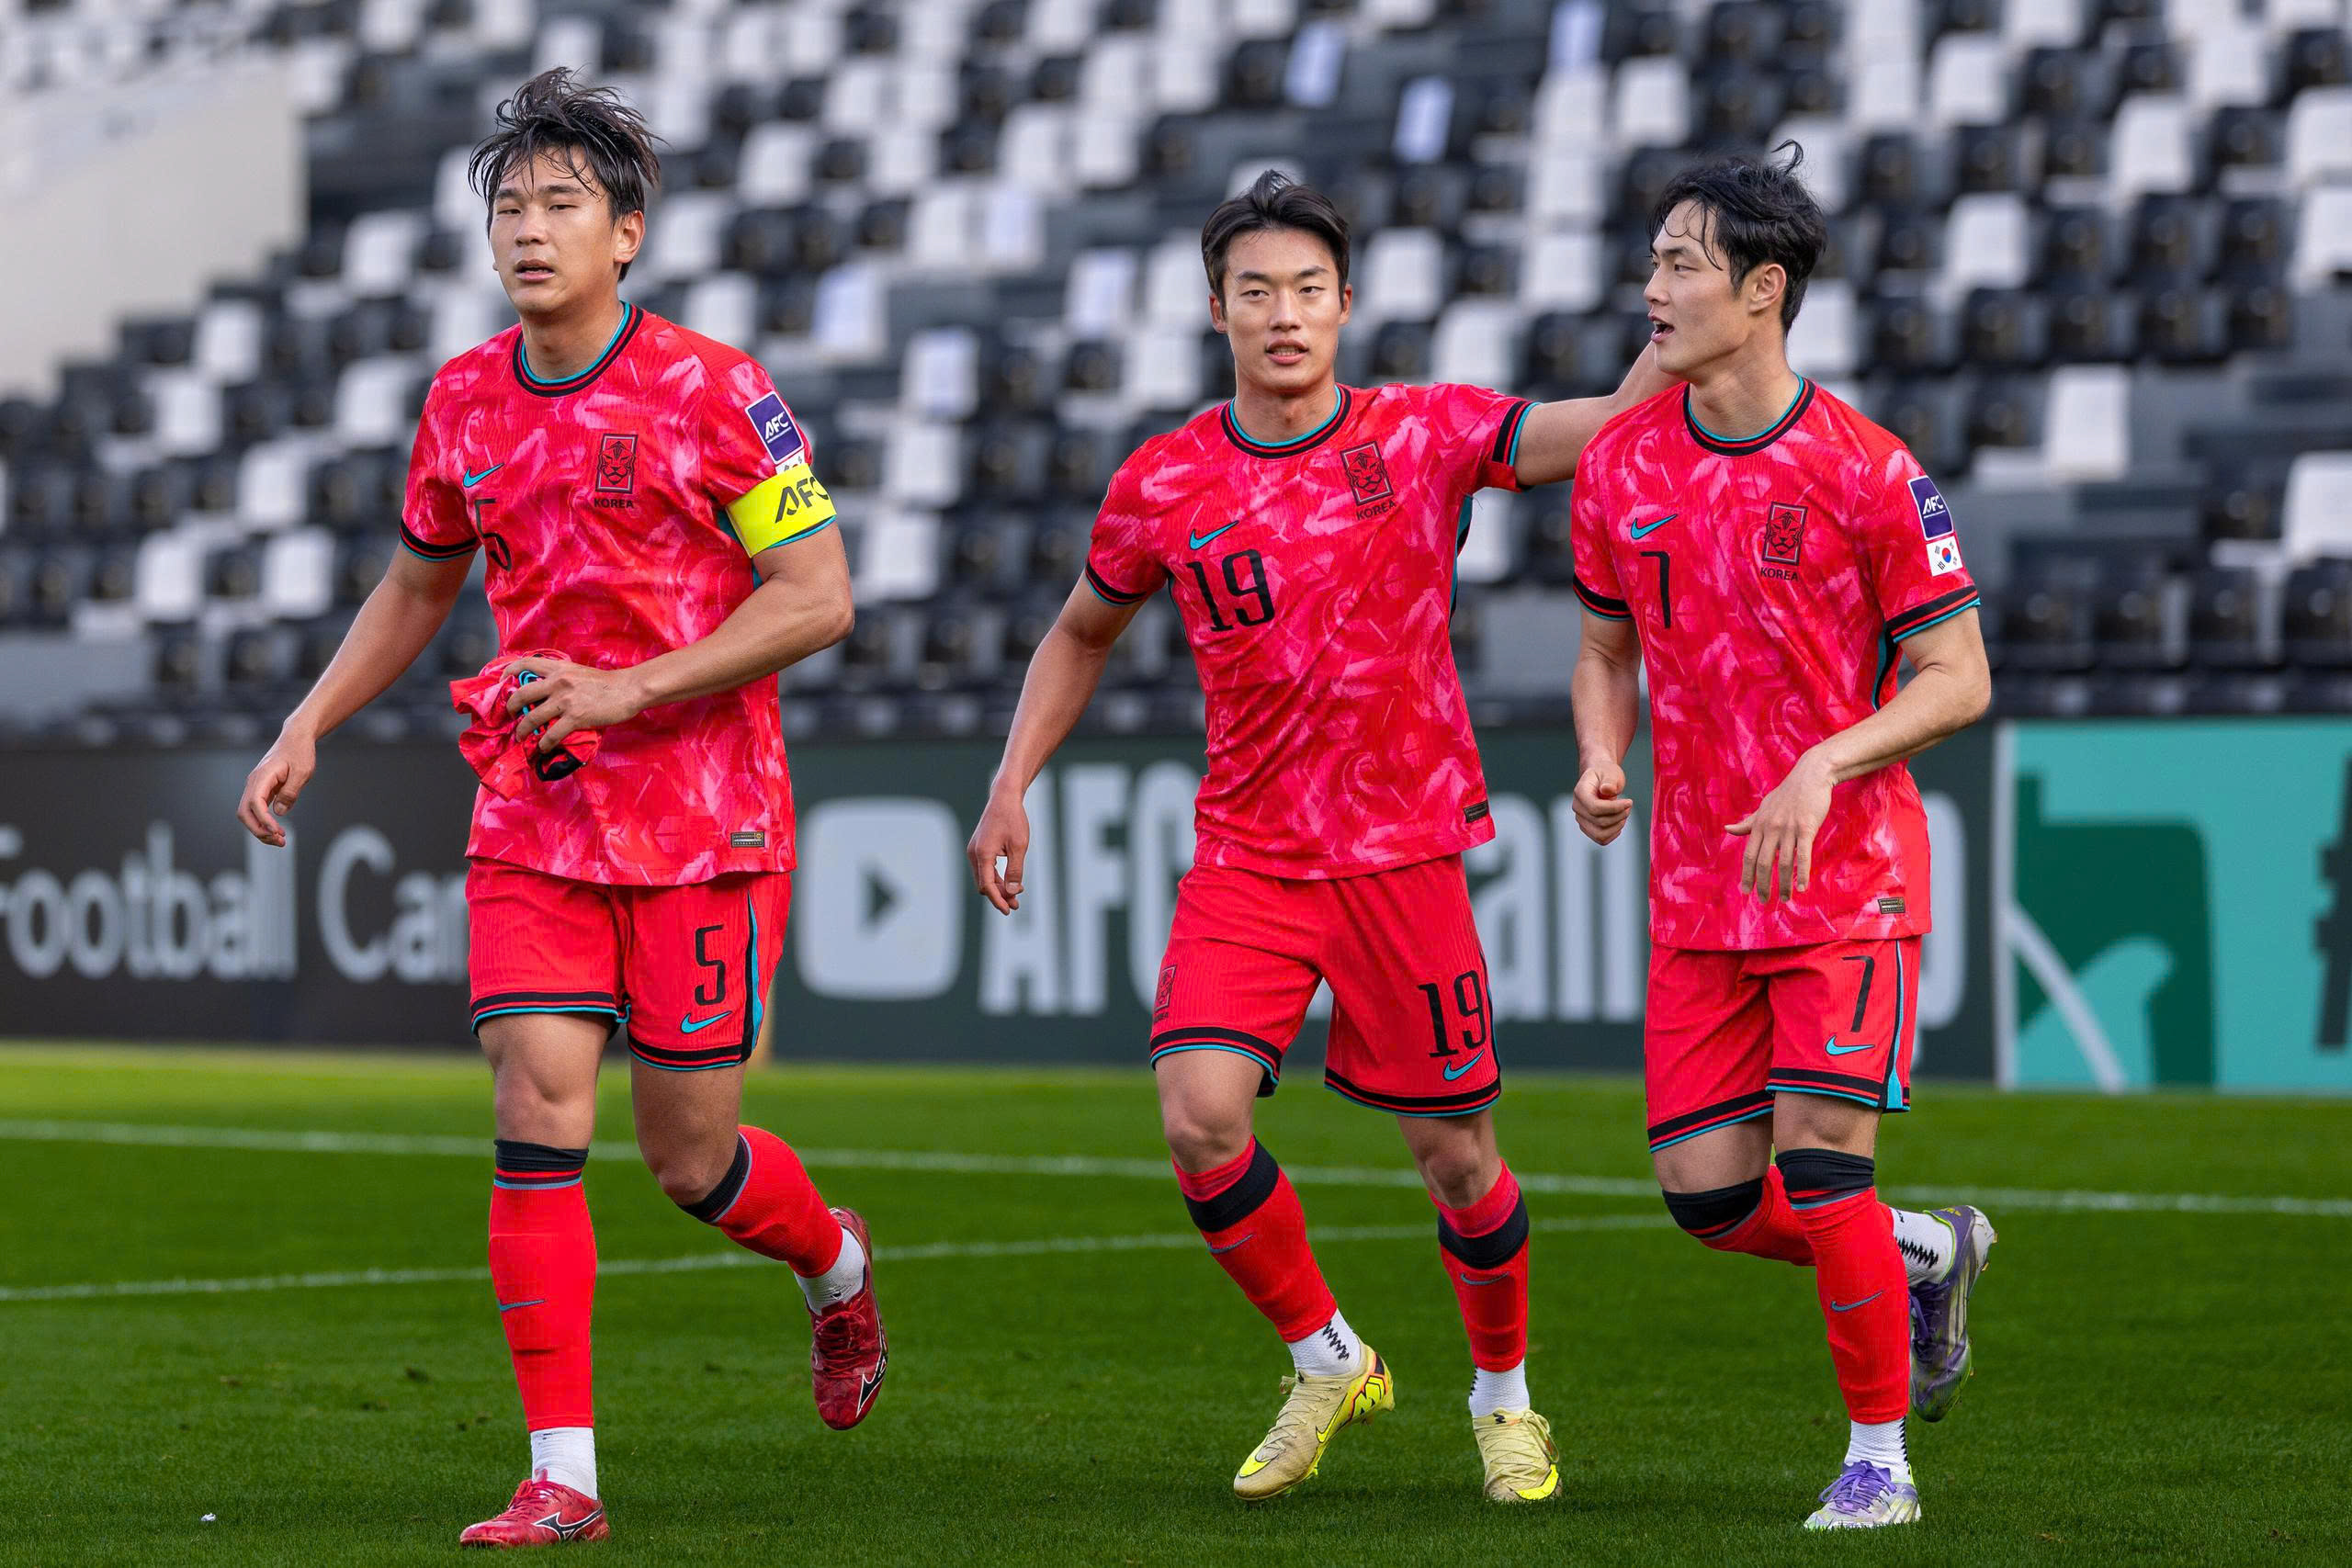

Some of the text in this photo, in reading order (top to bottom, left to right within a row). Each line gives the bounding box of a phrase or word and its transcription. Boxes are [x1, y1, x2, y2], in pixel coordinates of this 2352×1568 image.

[764, 411, 789, 439] AFC
[594, 497, 635, 509] KOREA
[775, 476, 830, 524] AFC
[1355, 500, 1397, 521] KOREA
[1922, 494, 1944, 514] AFC
[1185, 548, 1275, 632] 19
[1639, 550, 1671, 629] 7
[1759, 566, 1799, 581] KOREA
[694, 924, 726, 1006] 5
[1418, 969, 1487, 1058] 19
[1841, 955, 1876, 1033] 7
